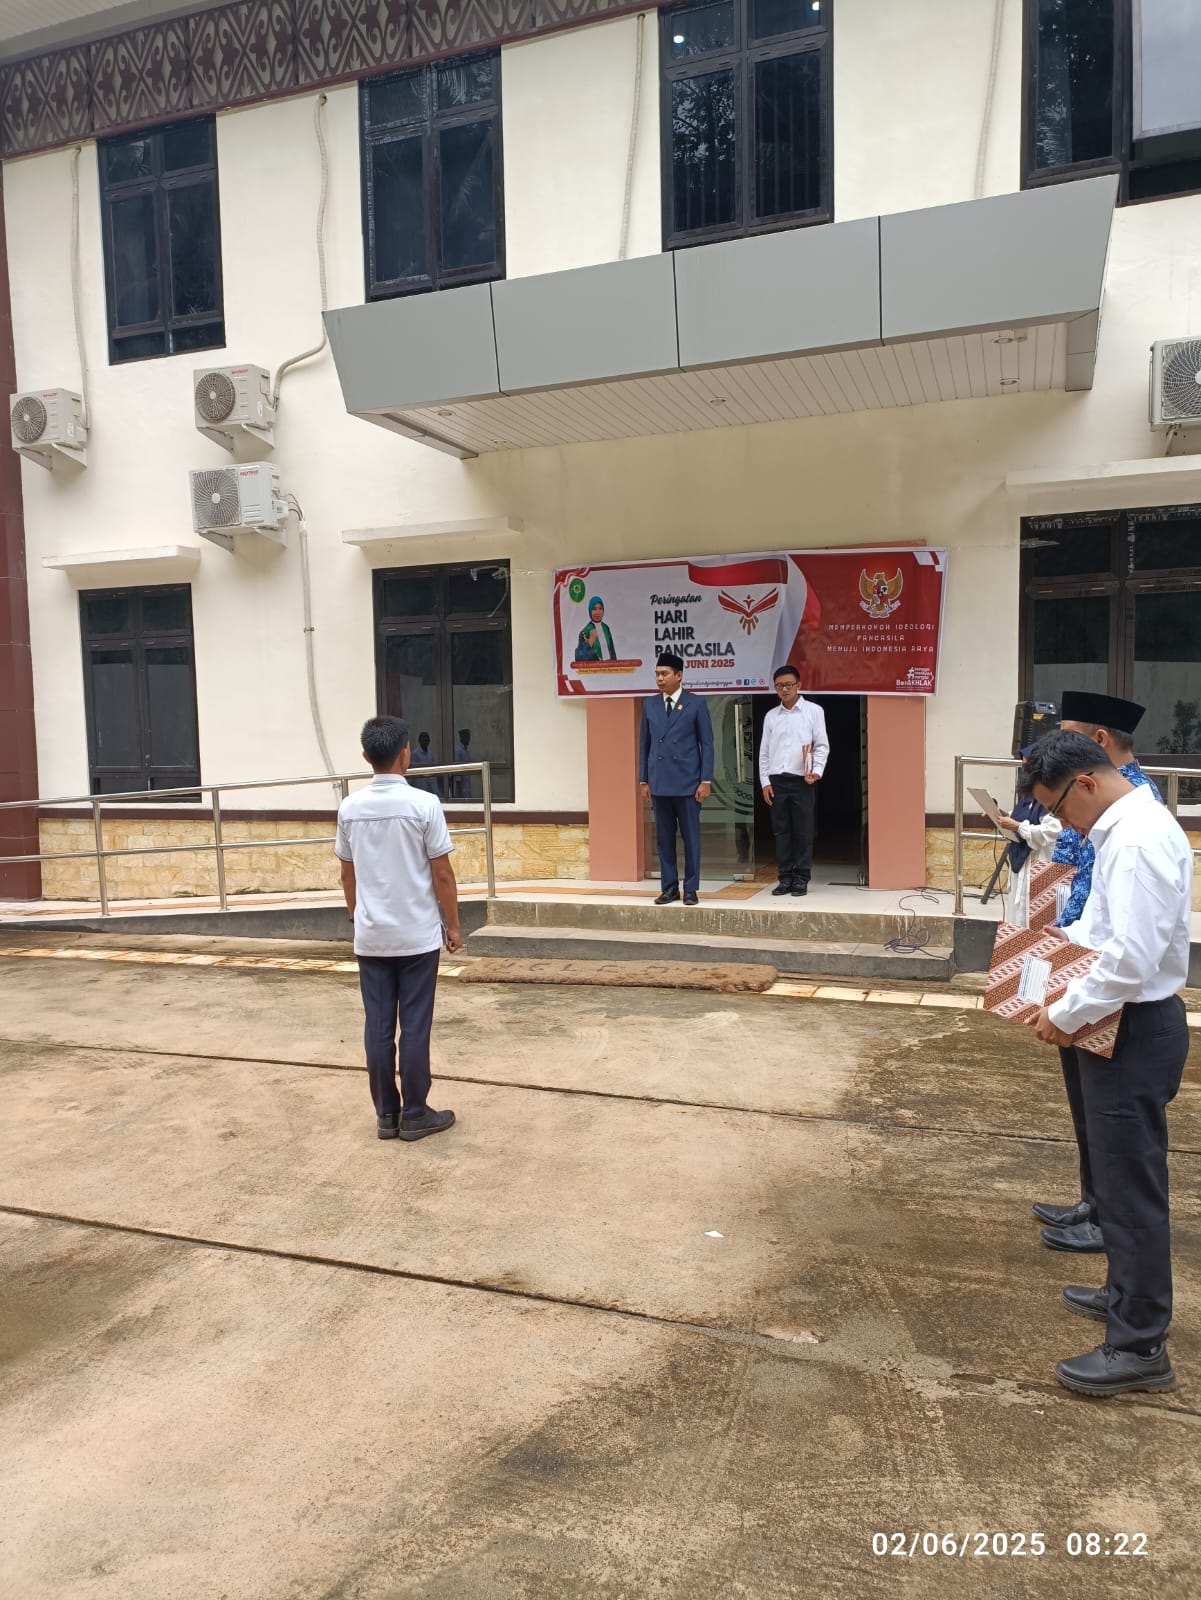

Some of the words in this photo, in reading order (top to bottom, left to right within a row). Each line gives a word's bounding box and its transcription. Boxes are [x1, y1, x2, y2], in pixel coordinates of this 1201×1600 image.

[650, 593, 702, 607] Peringatan
[654, 610, 687, 624] HARI
[654, 626, 695, 641] LAHIR
[895, 623, 935, 631] IDEOLOGI
[654, 641, 736, 658] PANCASILA
[685, 659, 709, 669] JUNI
[711, 659, 735, 669] 2025
